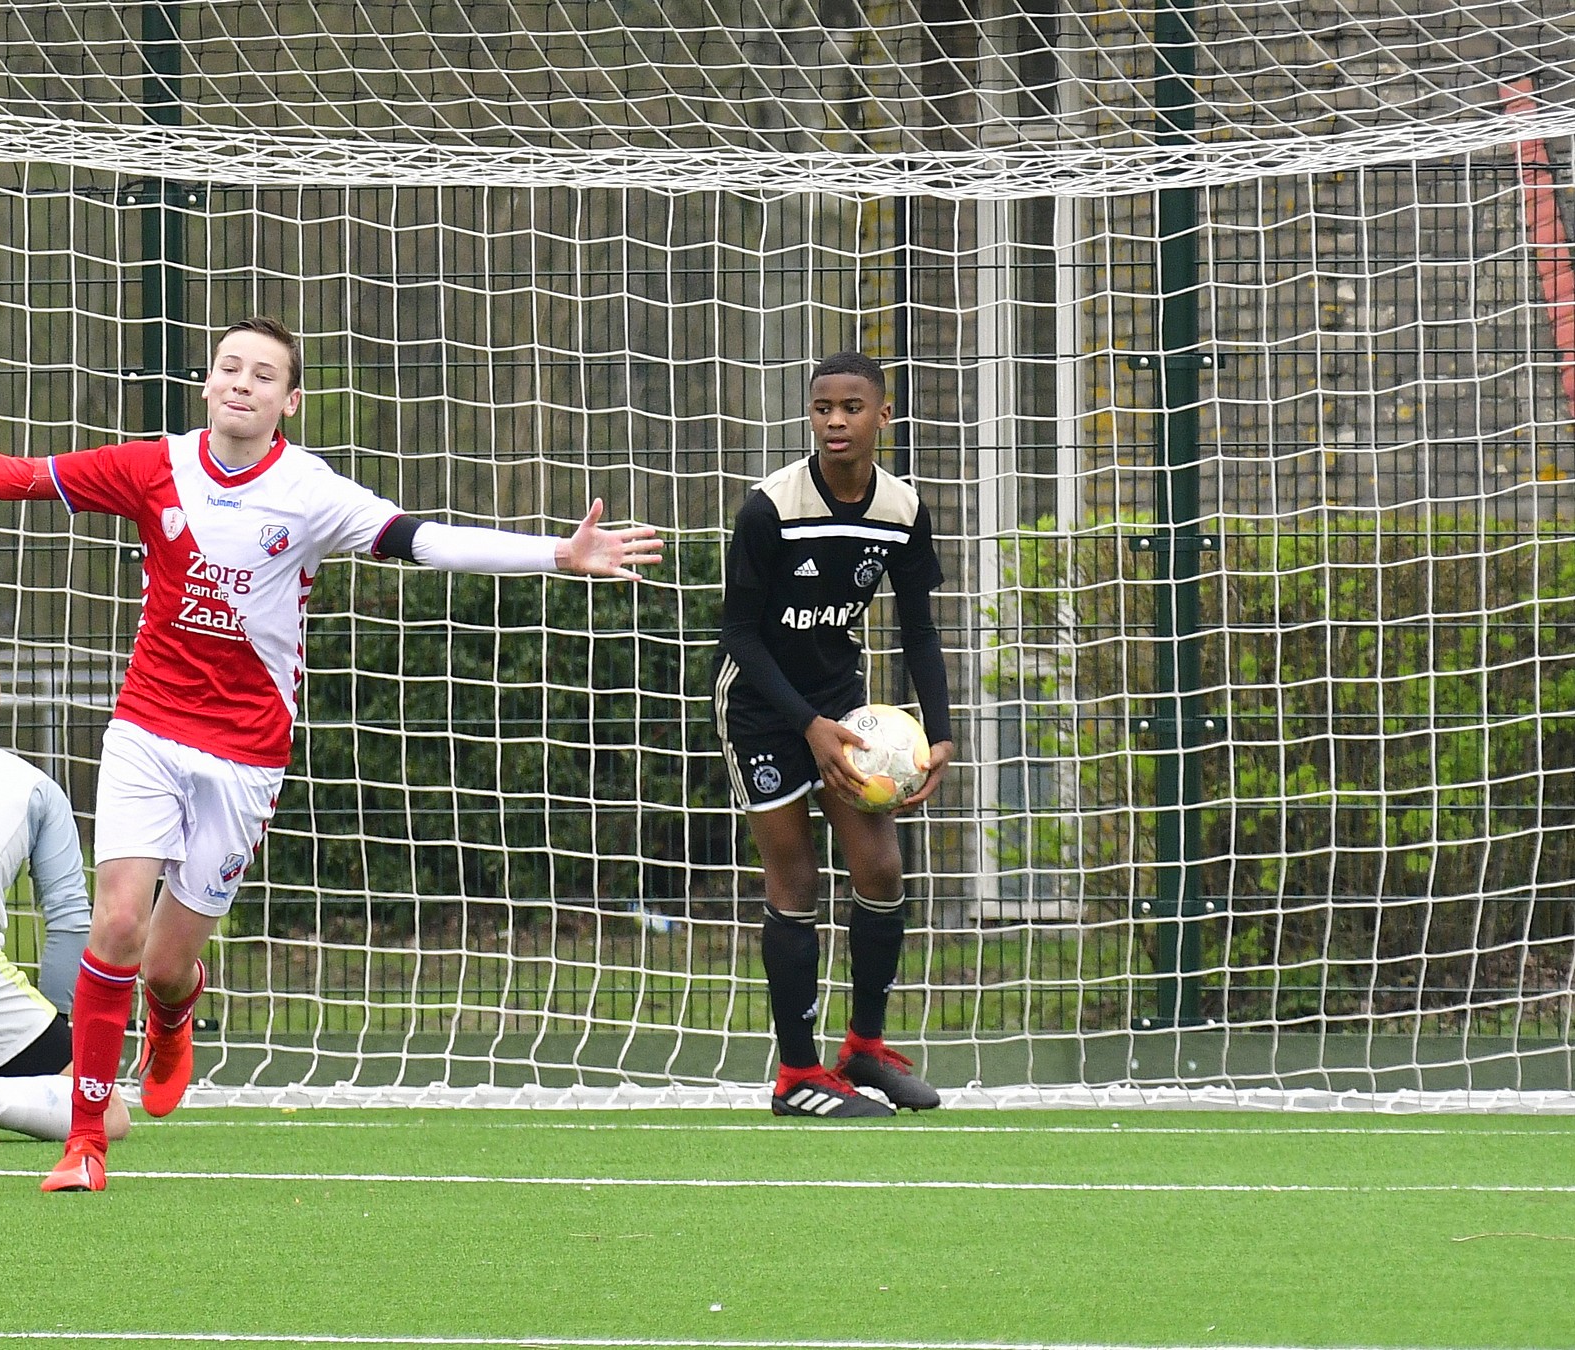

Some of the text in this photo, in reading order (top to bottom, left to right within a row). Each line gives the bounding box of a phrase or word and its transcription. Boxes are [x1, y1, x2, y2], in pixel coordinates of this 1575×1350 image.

[207, 494, 243, 510] hummel
[186, 550, 254, 595] Zorg
[184, 582, 230, 602] van de
[178, 596, 248, 633] Zaak
